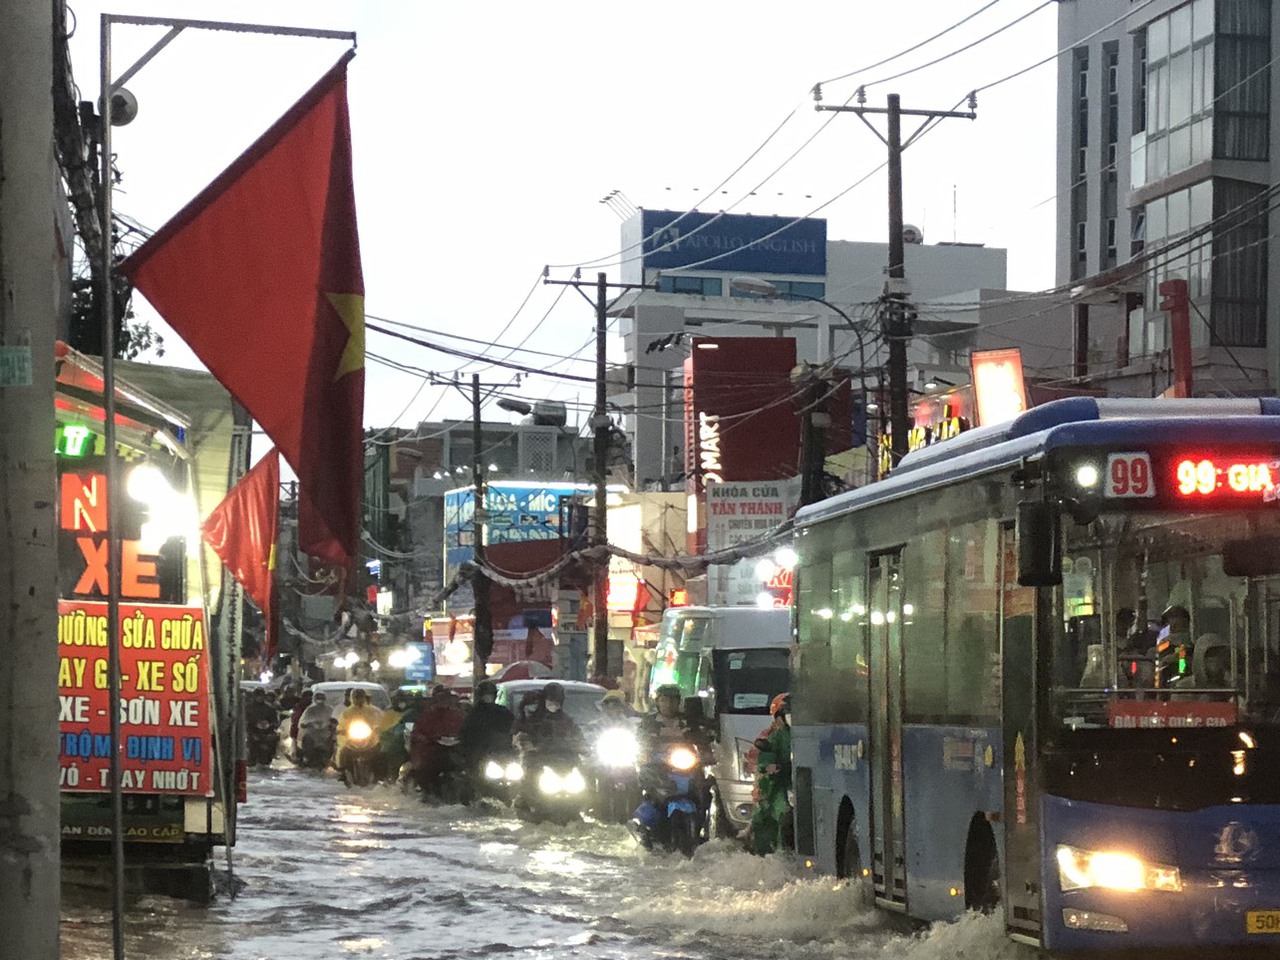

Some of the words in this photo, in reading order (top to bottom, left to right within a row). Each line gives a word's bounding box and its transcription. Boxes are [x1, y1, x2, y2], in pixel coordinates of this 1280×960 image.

[699, 411, 722, 470] MART
[1111, 458, 1149, 495] 99
[1227, 463, 1274, 492] GIA
[528, 490, 556, 512] MÍC
[74, 537, 161, 598] XE
[122, 610, 156, 649] SỬA
[161, 614, 204, 651] CHỮA
[136, 660, 165, 692] XE
[172, 653, 202, 693] SỐ
[58, 695, 91, 723] XE
[169, 700, 200, 727] XE
[126, 735, 175, 764] ĐỊNH
[182, 736, 202, 766] VỊ
[98, 768, 146, 789] TAY
[152, 767, 201, 791] NHỚT
